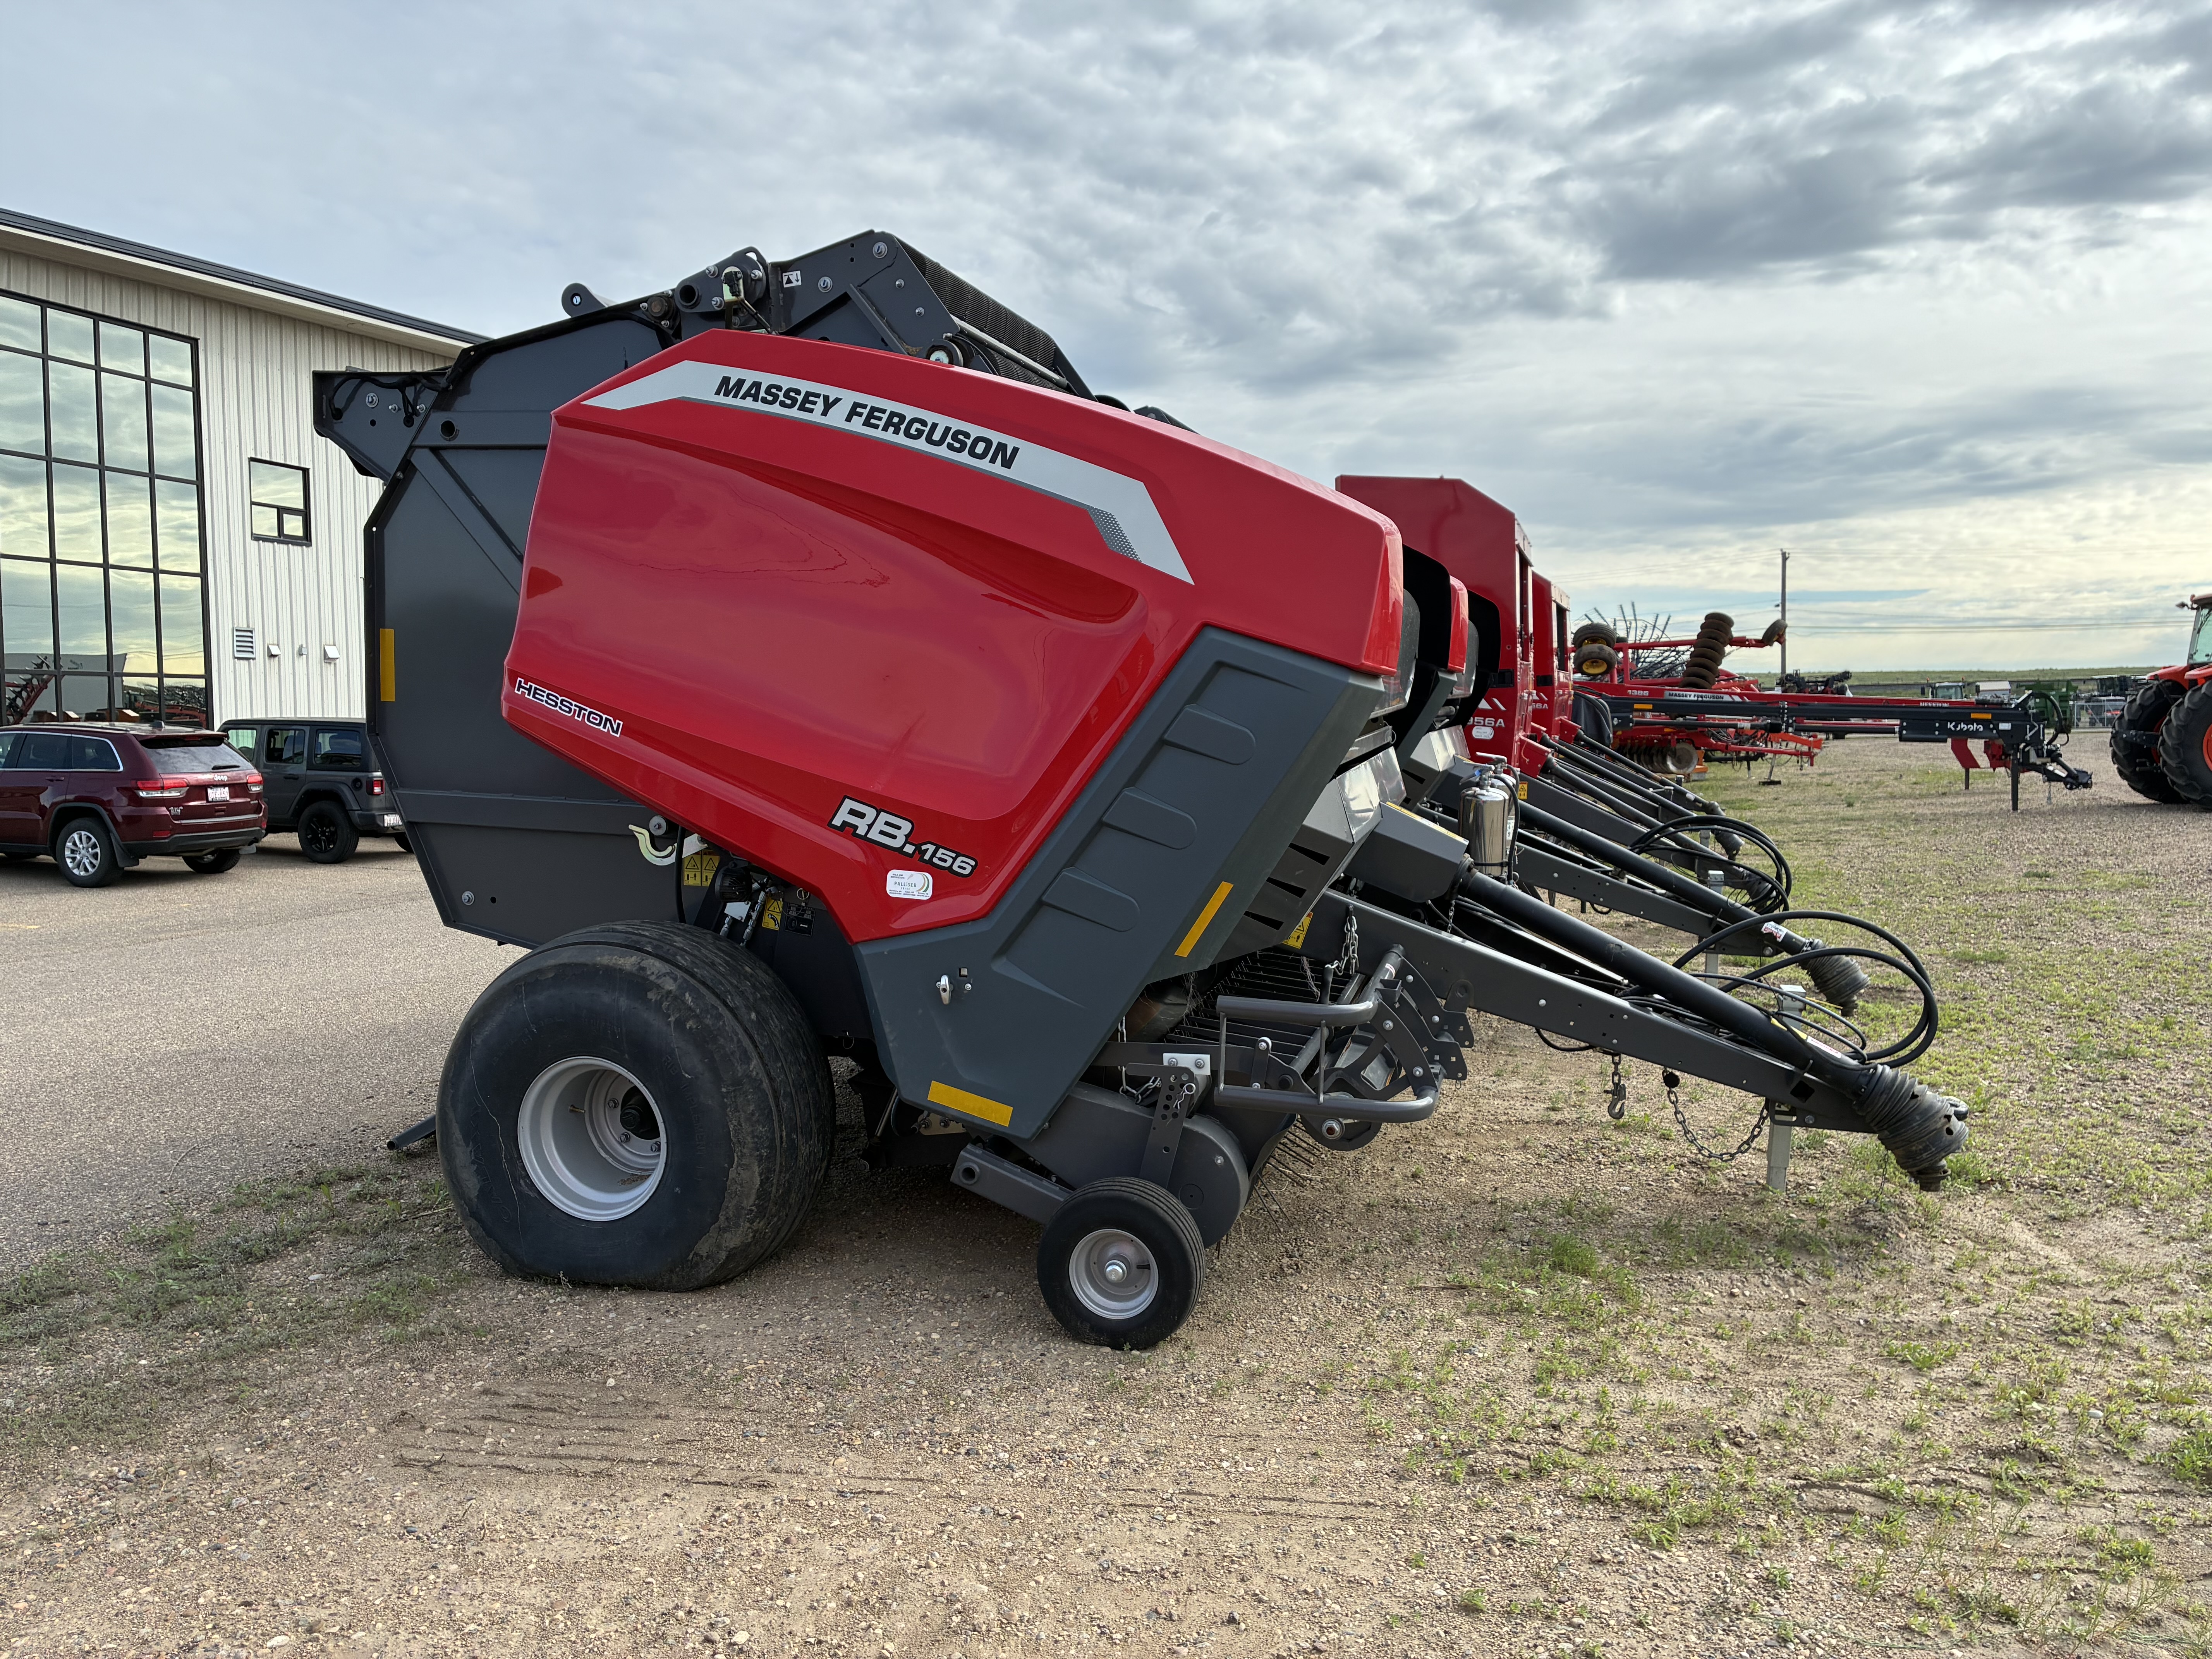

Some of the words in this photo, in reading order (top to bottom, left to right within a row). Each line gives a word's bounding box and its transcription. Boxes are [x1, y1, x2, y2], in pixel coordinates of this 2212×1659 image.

[714, 375, 842, 417] MASSEY
[845, 401, 1020, 469] FERGUSON
[514, 677, 623, 738] HESSTON
[1947, 722, 1983, 732] Kubota
